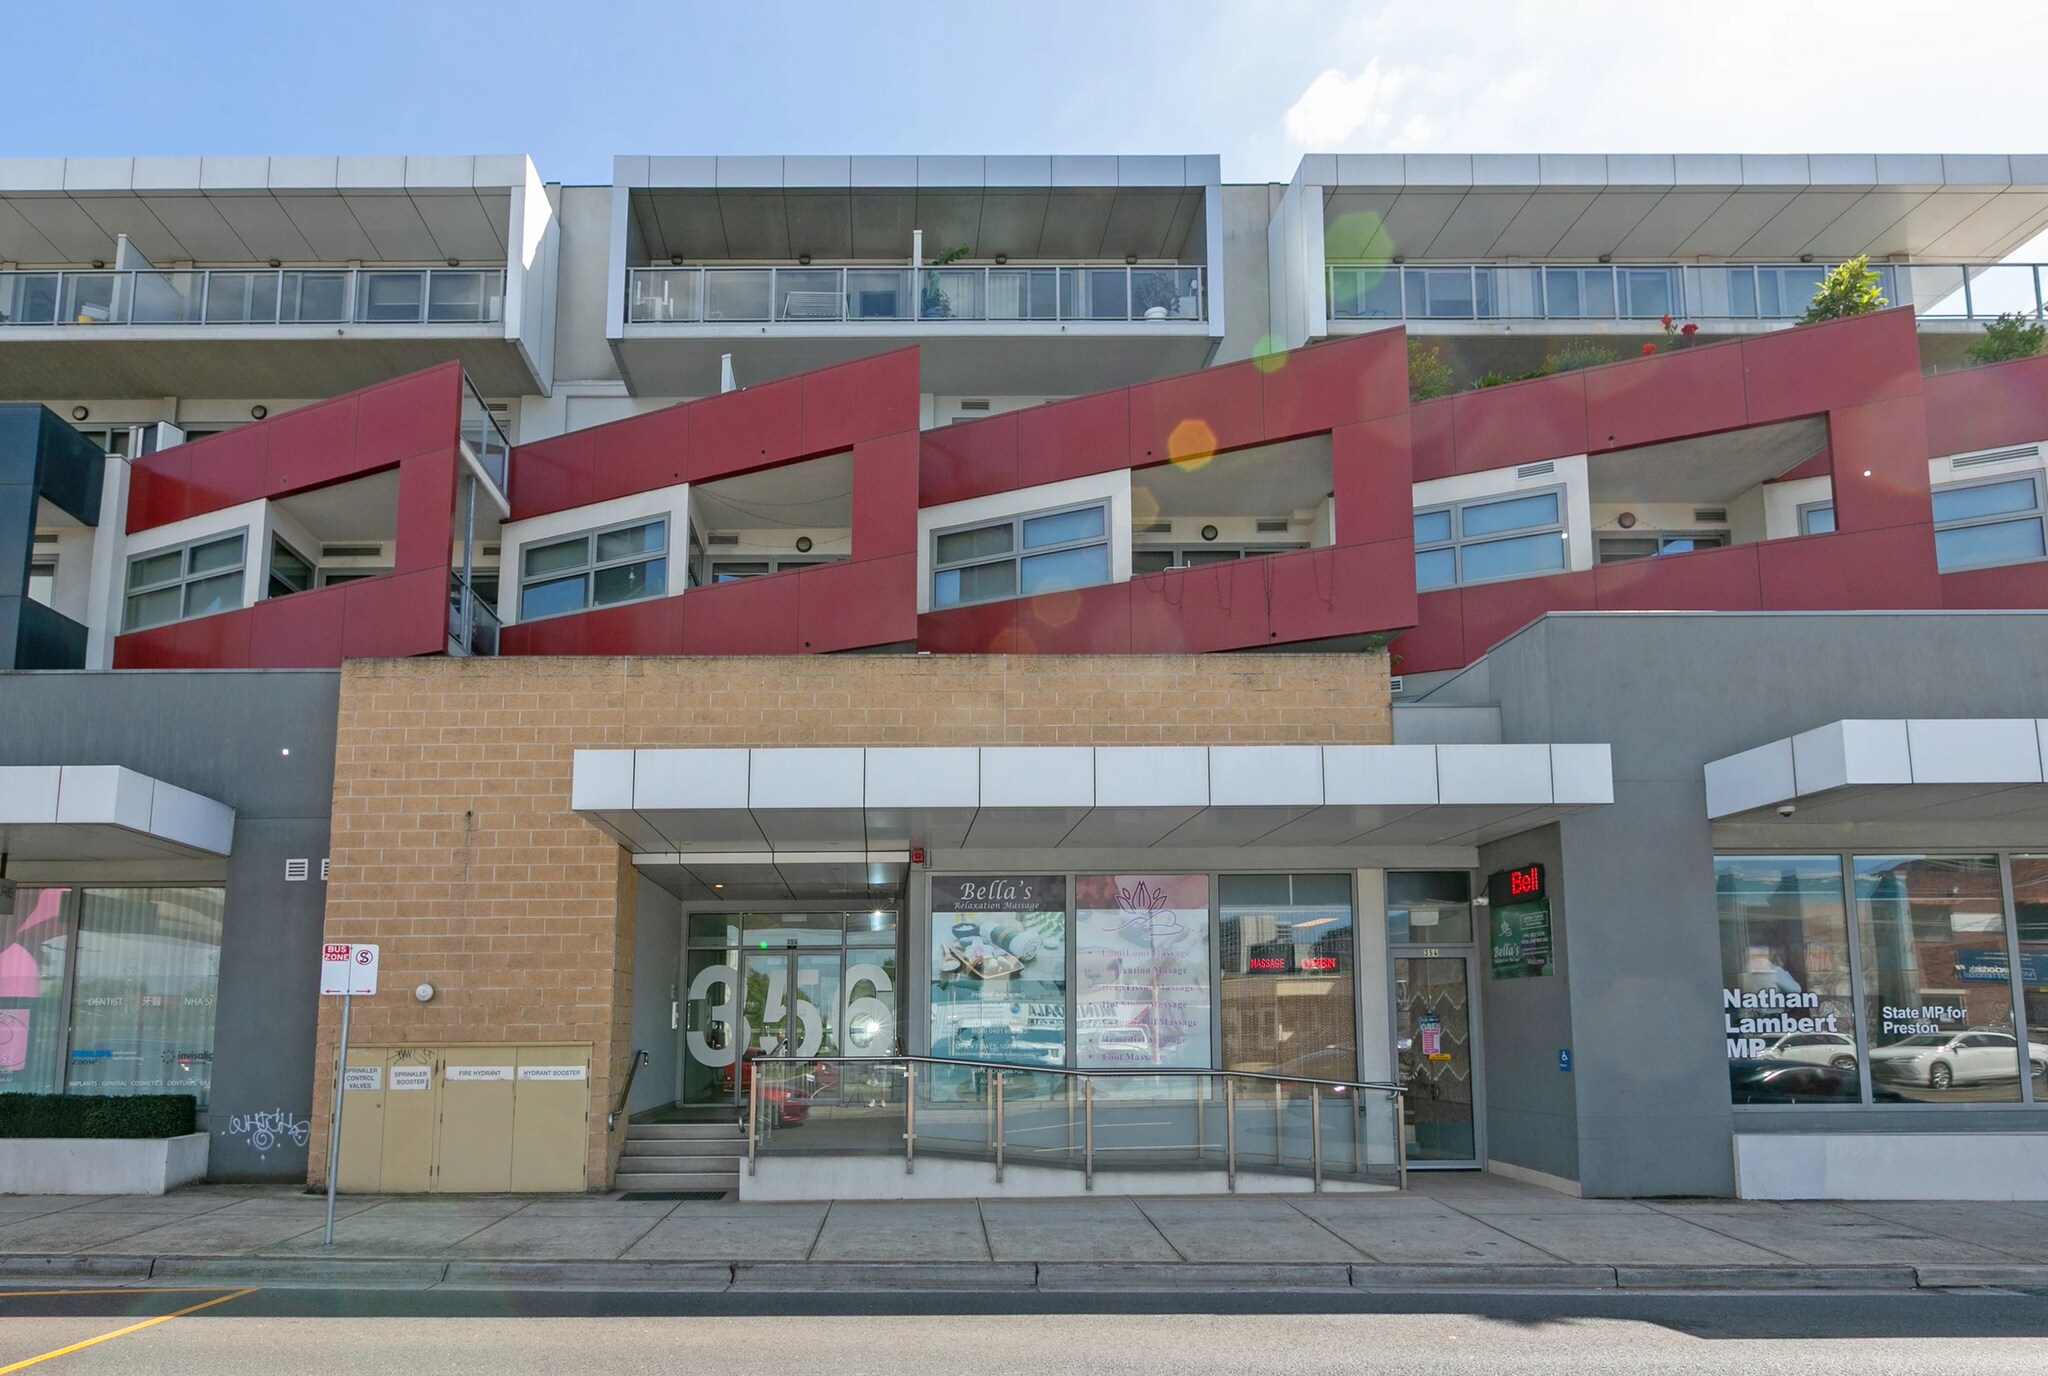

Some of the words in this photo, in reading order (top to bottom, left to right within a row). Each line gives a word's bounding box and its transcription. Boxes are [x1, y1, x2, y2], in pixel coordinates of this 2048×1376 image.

[1511, 867, 1539, 895] Bell
[961, 880, 1033, 900] Bella's
[954, 901, 1001, 910] Relaxation
[1003, 901, 1040, 911] Massage
[325, 953, 350, 961] ZONE
[1494, 943, 1520, 958] Bella's
[1250, 958, 1285, 969] MASSAGE
[1301, 957, 1336, 969] OPEN
[88, 997, 123, 1006] DENTIST
[1723, 988, 1819, 1009] Nathan
[687, 963, 894, 1068] 356
[1882, 1006, 1920, 1019] State
[1922, 1006, 1945, 1019] MP
[1946, 1006, 1967, 1019] for
[1725, 1013, 1838, 1033] Lambert
[1883, 1021, 1939, 1034] Preston
[1727, 1038, 1766, 1058] MP
